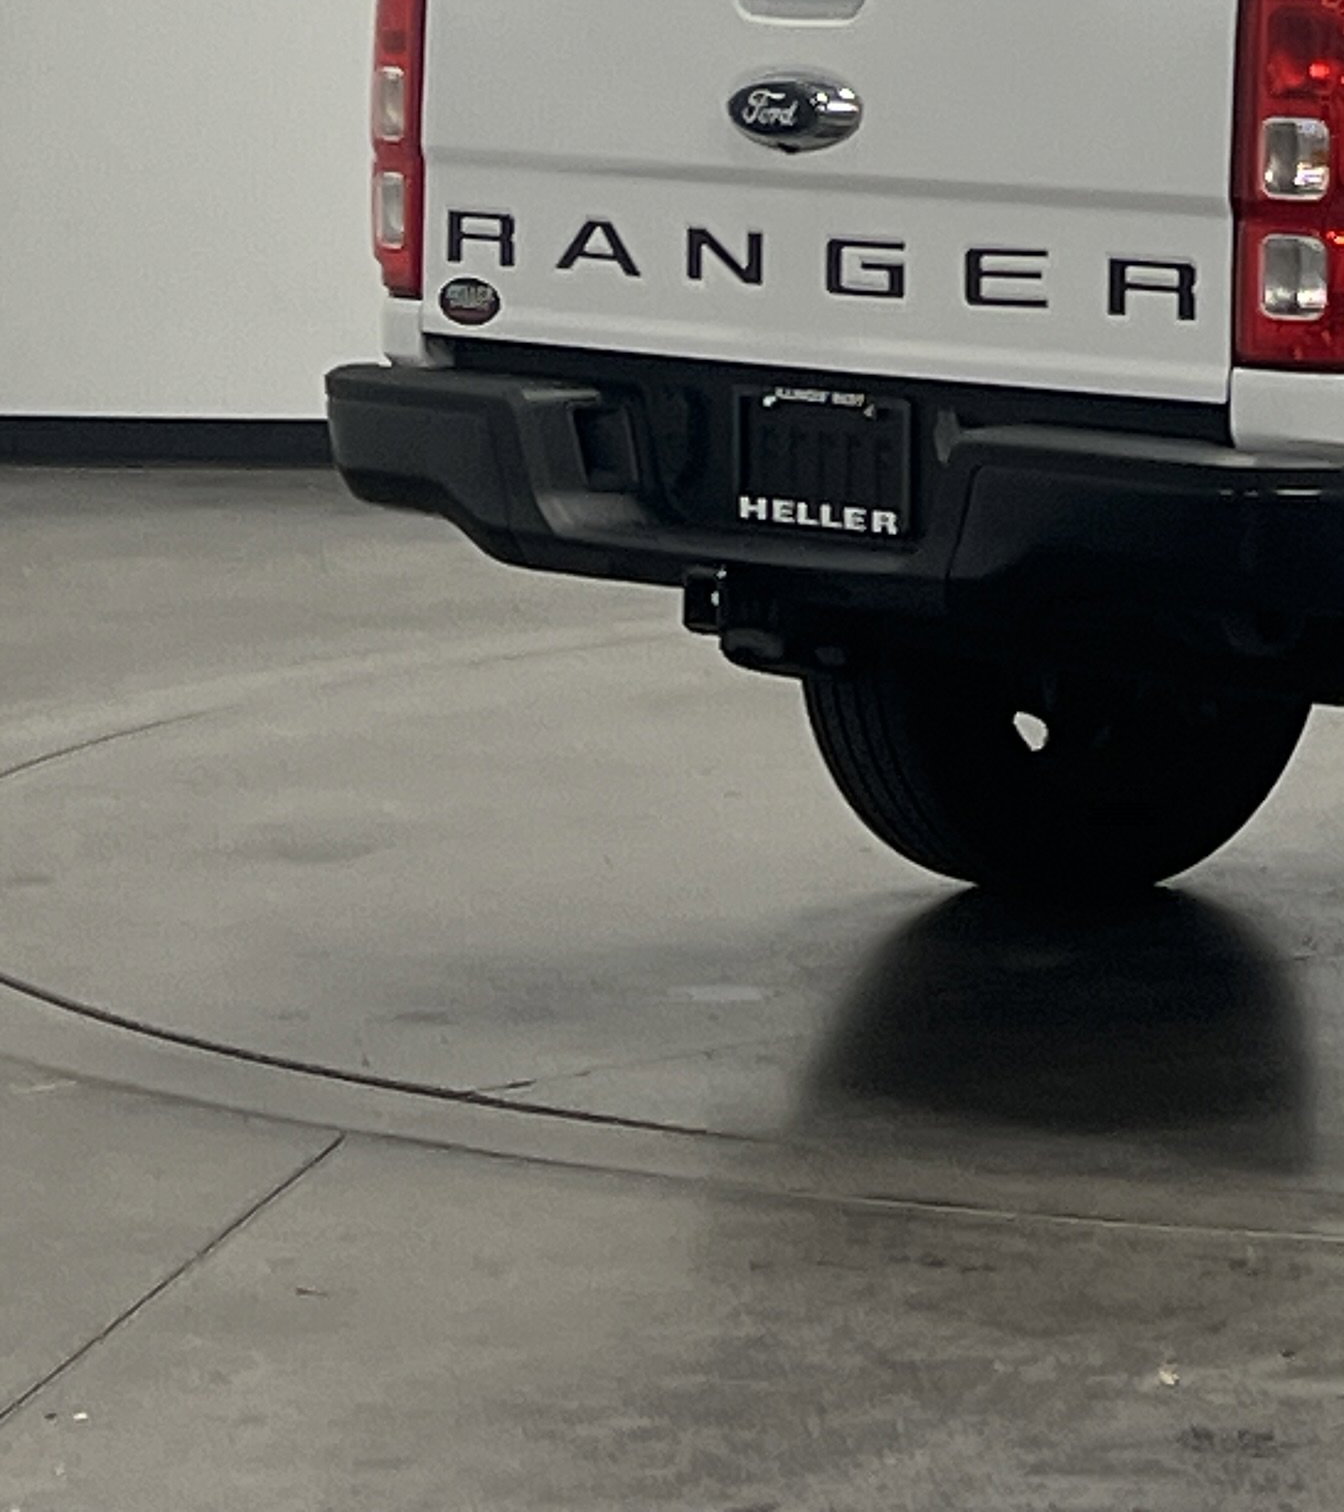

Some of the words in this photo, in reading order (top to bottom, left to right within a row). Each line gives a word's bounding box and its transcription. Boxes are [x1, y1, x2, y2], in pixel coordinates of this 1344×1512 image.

[742, 88, 798, 126] Ford
[447, 209, 1197, 321] RANGER
[739, 496, 898, 535] HELLER
